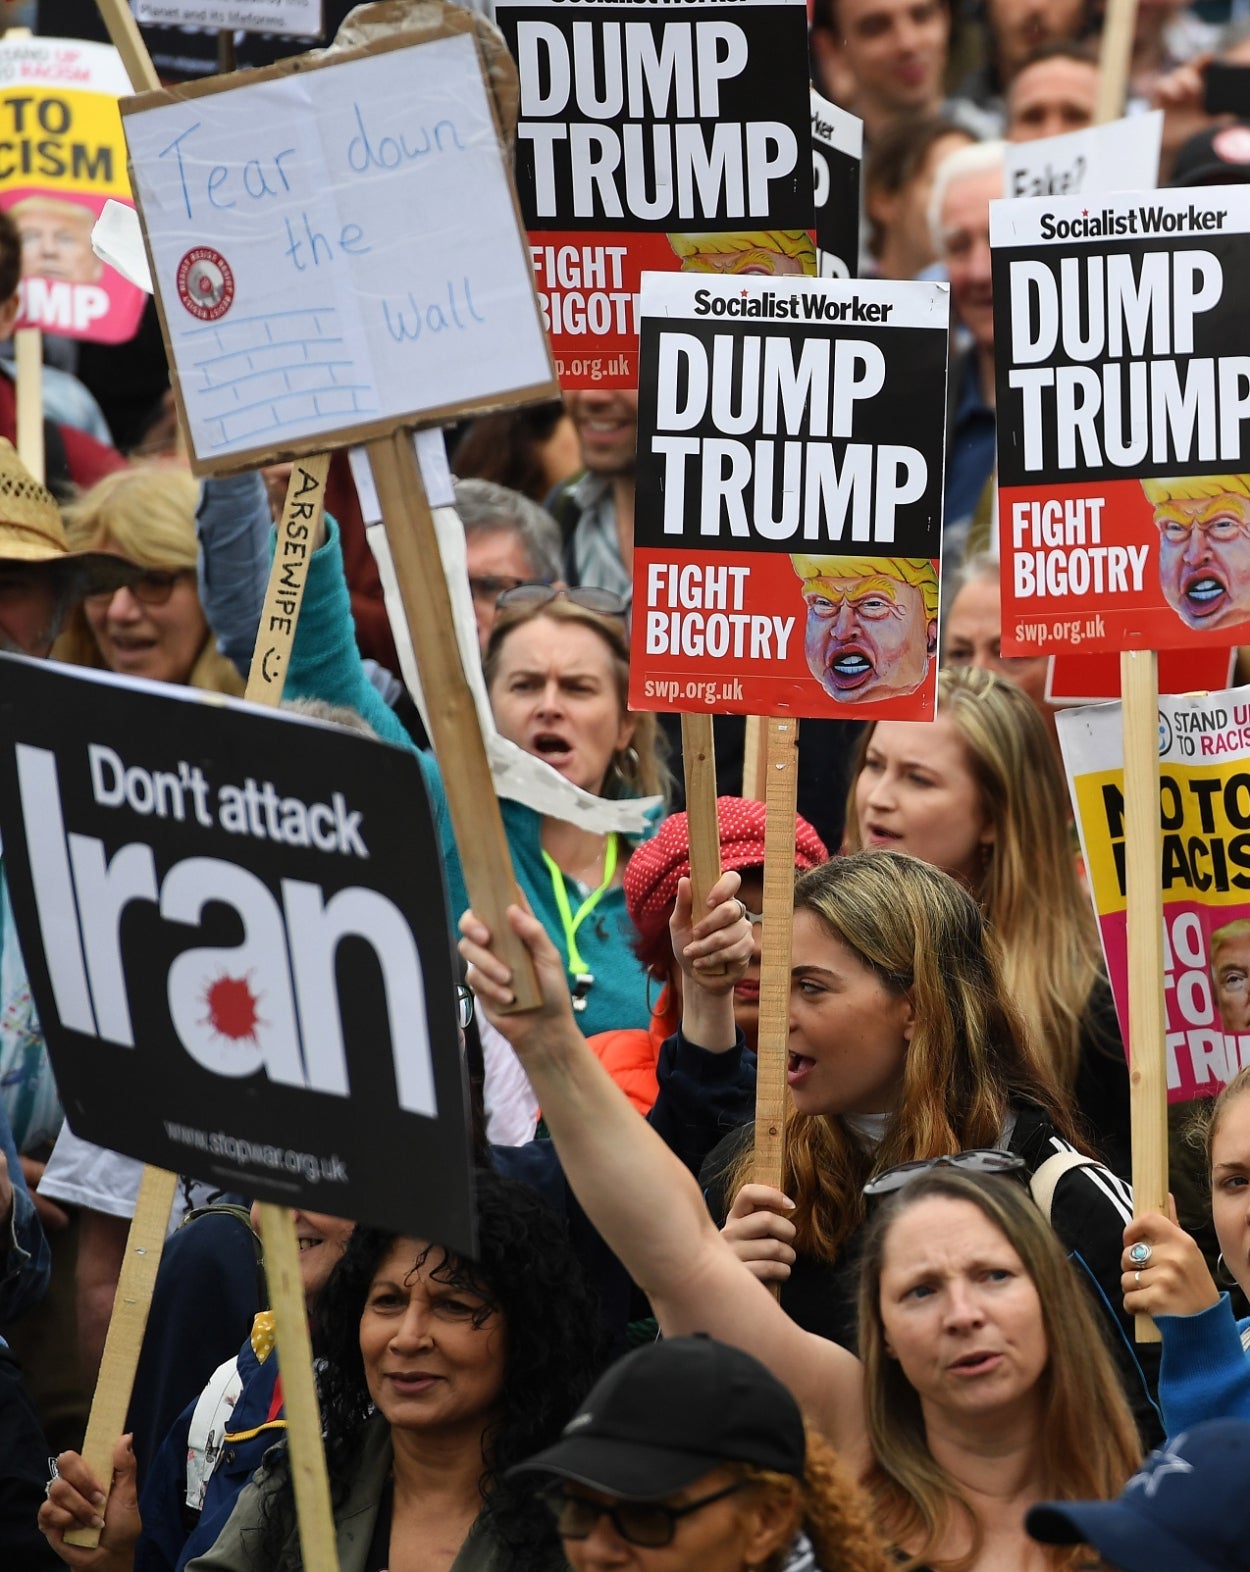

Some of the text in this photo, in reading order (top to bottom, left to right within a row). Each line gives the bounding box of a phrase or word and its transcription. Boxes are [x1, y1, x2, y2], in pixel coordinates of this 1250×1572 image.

[517, 21, 748, 119] DUMP
[4, 97, 72, 135] TO
[159, 103, 466, 220] Tear down
[518, 121, 798, 220] TRUMP
[285, 213, 371, 273] the
[1040, 204, 1228, 240] Socialist Worker
[694, 289, 893, 322] Socialist Worker
[1009, 249, 1224, 364] DUMP
[656, 332, 886, 438] DUMP
[651, 435, 928, 543] TRUMP
[269, 467, 320, 636] ARSEWIPE
[1012, 497, 1106, 549] FIGHT
[647, 563, 751, 610] FIGHT
[1013, 544, 1150, 598] BIGOTRY
[646, 611, 796, 660] BIGOTRY
[1015, 614, 1106, 644] swp.org.uk
[645, 679, 744, 705] swp.org.uk
[1174, 709, 1228, 733] STAND
[1177, 735, 1195, 756] TO
[88, 742, 371, 859] Don't attack
[15, 742, 438, 1118] Iran
[163, 1119, 350, 1184] www.stopwar.org.uk
